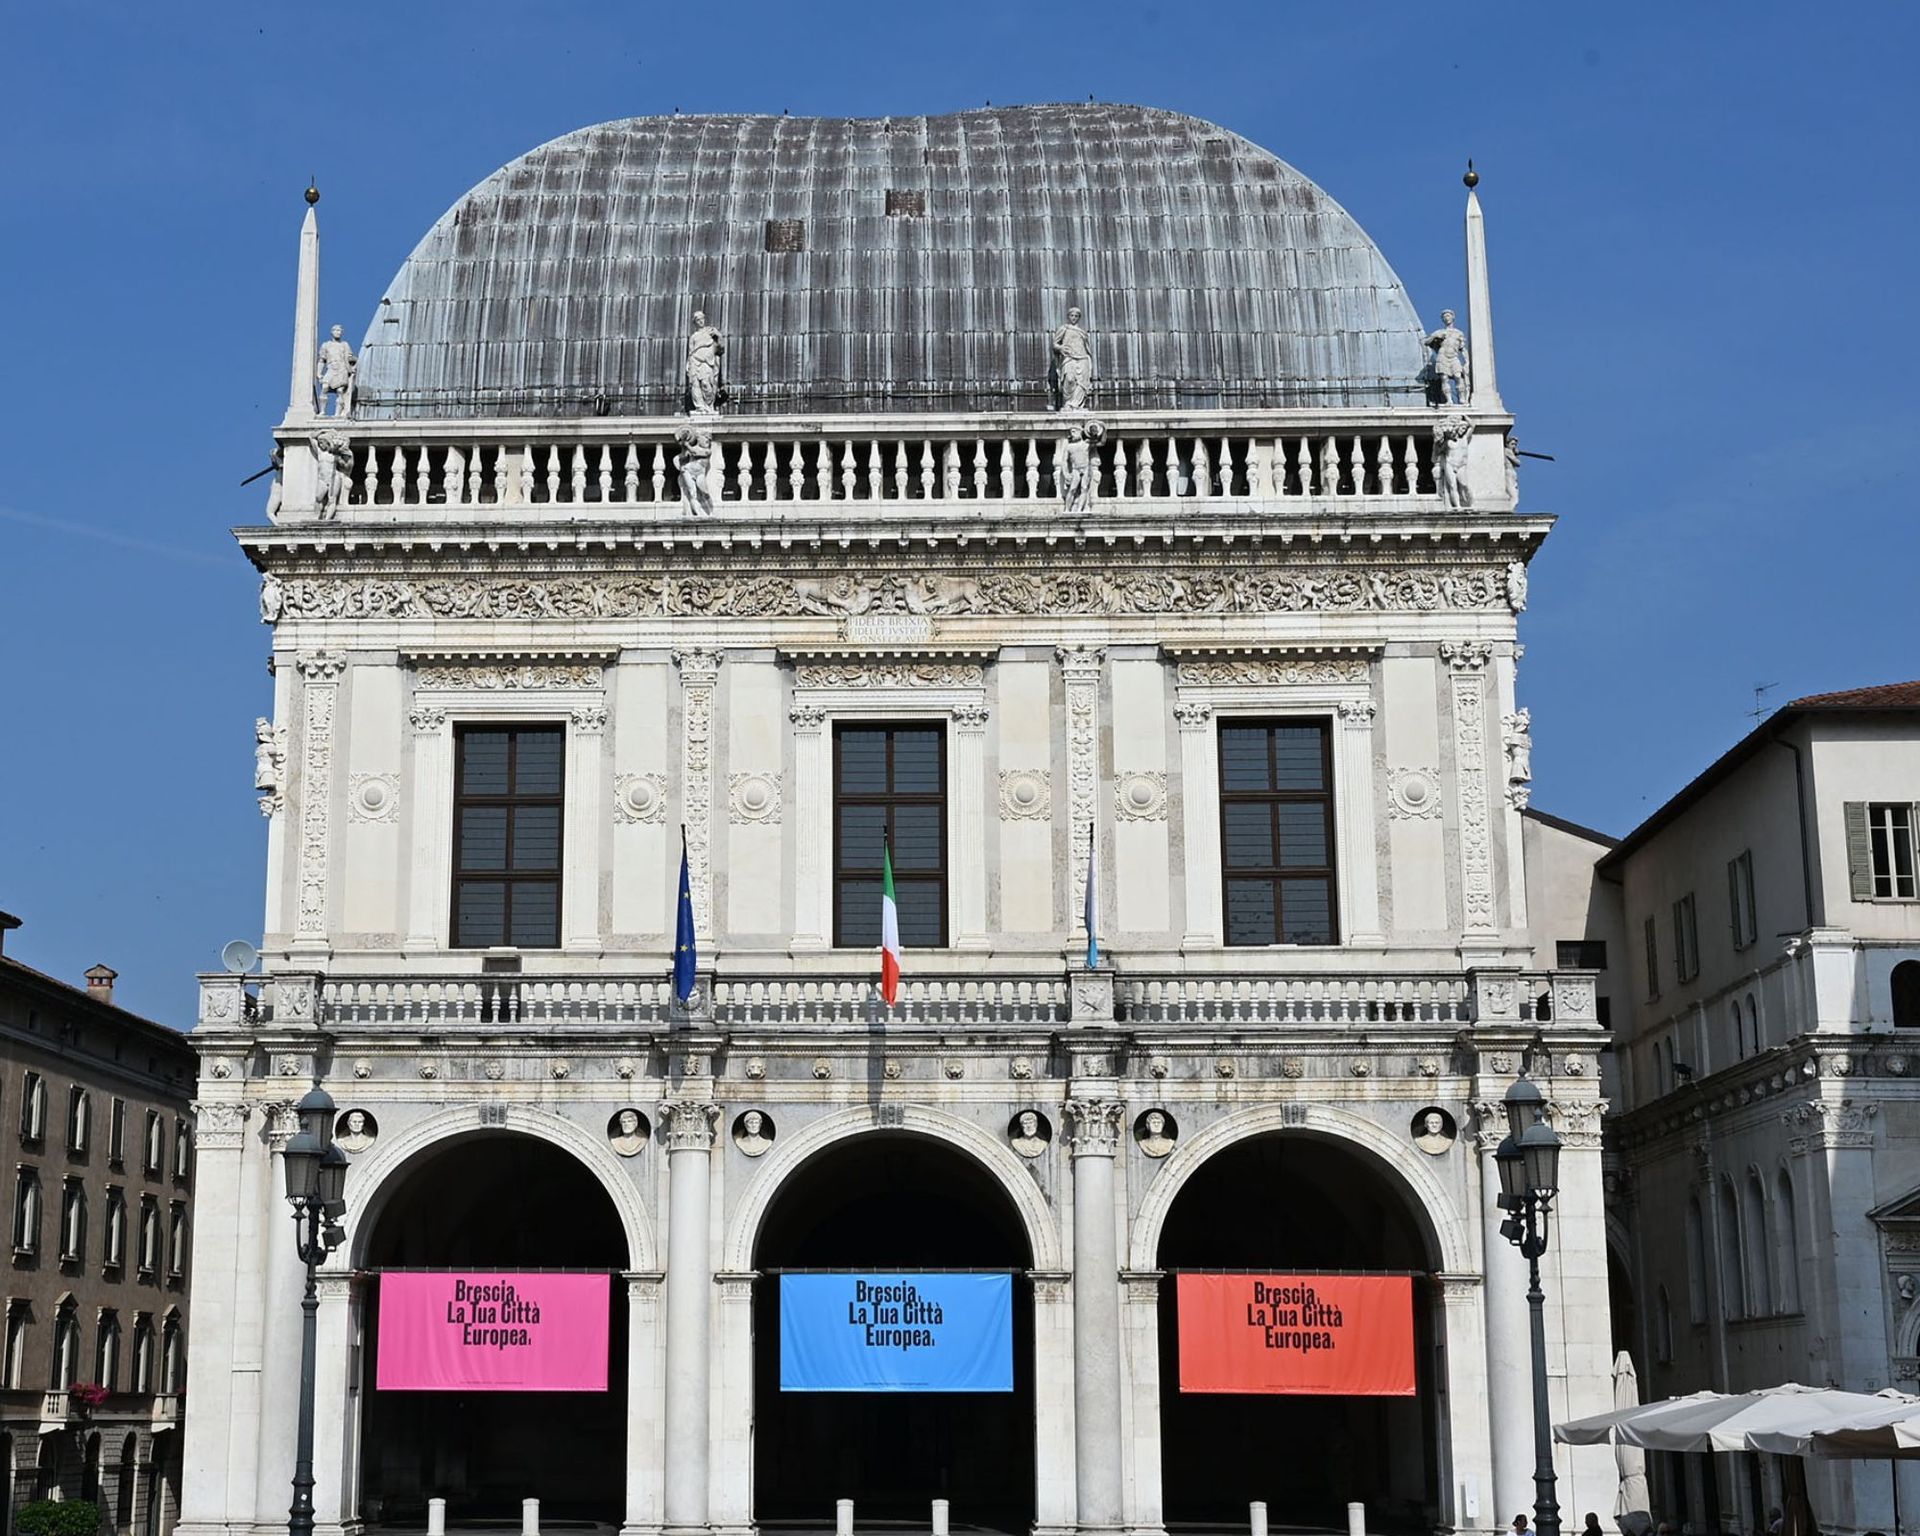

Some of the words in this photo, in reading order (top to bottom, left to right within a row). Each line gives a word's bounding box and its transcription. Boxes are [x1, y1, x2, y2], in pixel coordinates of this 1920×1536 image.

[889, 617, 929, 626] BRIXIA
[447, 1301, 465, 1324] La
[469, 1301, 496, 1324] Tua
[501, 1301, 540, 1324] Città
[849, 1302, 867, 1325] La
[871, 1302, 898, 1325] Tua
[903, 1302, 943, 1325] Città
[1247, 1303, 1265, 1326] La
[1269, 1303, 1298, 1327] Tua
[1302, 1303, 1342, 1328] Città
